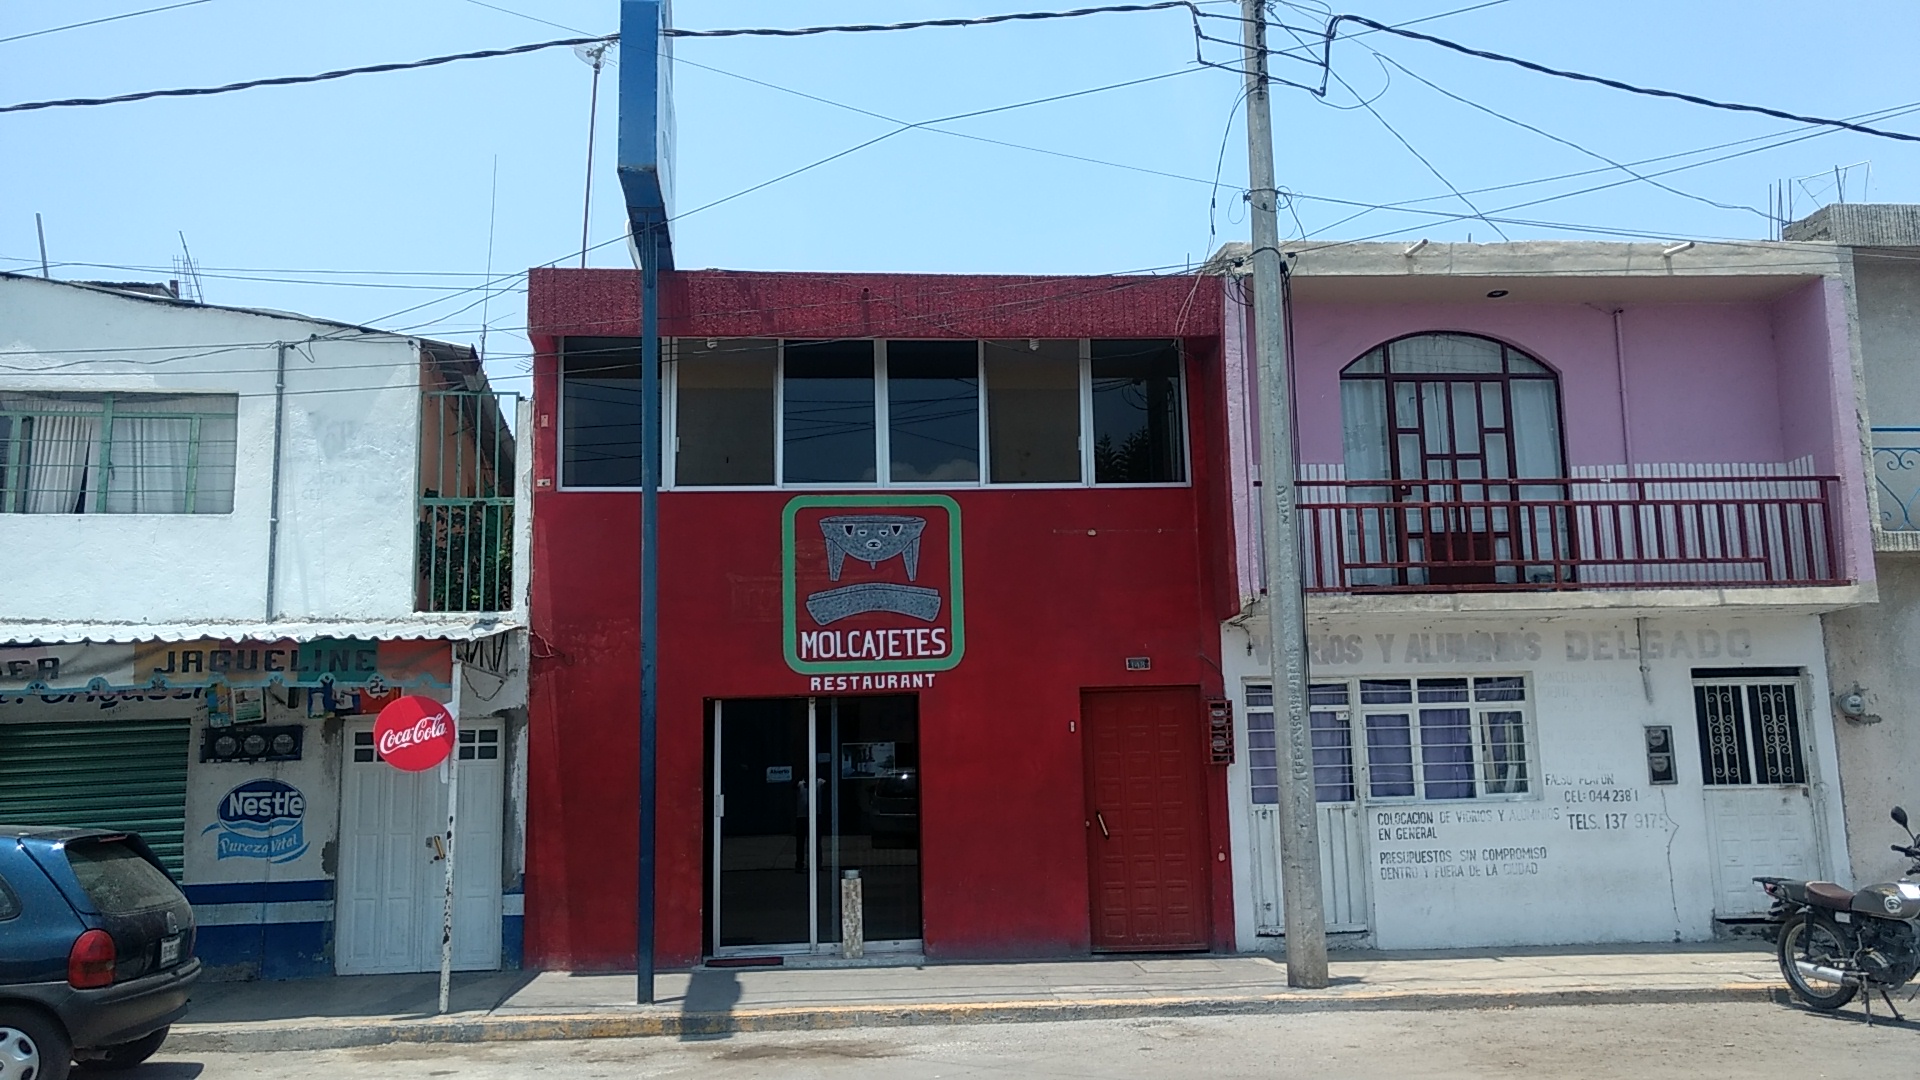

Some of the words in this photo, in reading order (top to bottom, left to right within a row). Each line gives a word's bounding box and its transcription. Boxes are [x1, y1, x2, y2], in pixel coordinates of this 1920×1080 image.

[801, 628, 946, 660] MOLCAJETES
[1374, 633, 1395, 664] Y
[1564, 628, 1751, 662] DELGADO
[810, 674, 936, 691] RESTAURANT
[380, 712, 447, 755] Coca-Cola
[1377, 811, 1434, 826] COLOCACION
[1498, 809, 1505, 822] Y
[1605, 813, 1628, 830] 137
[1379, 827, 1391, 841] EN
[1396, 826, 1438, 840] GENERAL
[220, 837, 268, 854] Pureza
[270, 833, 298, 853] Vital
[1380, 850, 1452, 865] PRESUPUESTOS
[1460, 849, 1476, 862] SIN
[1482, 847, 1546, 861] COMPROMISO
[1485, 863, 1498, 877] LA
